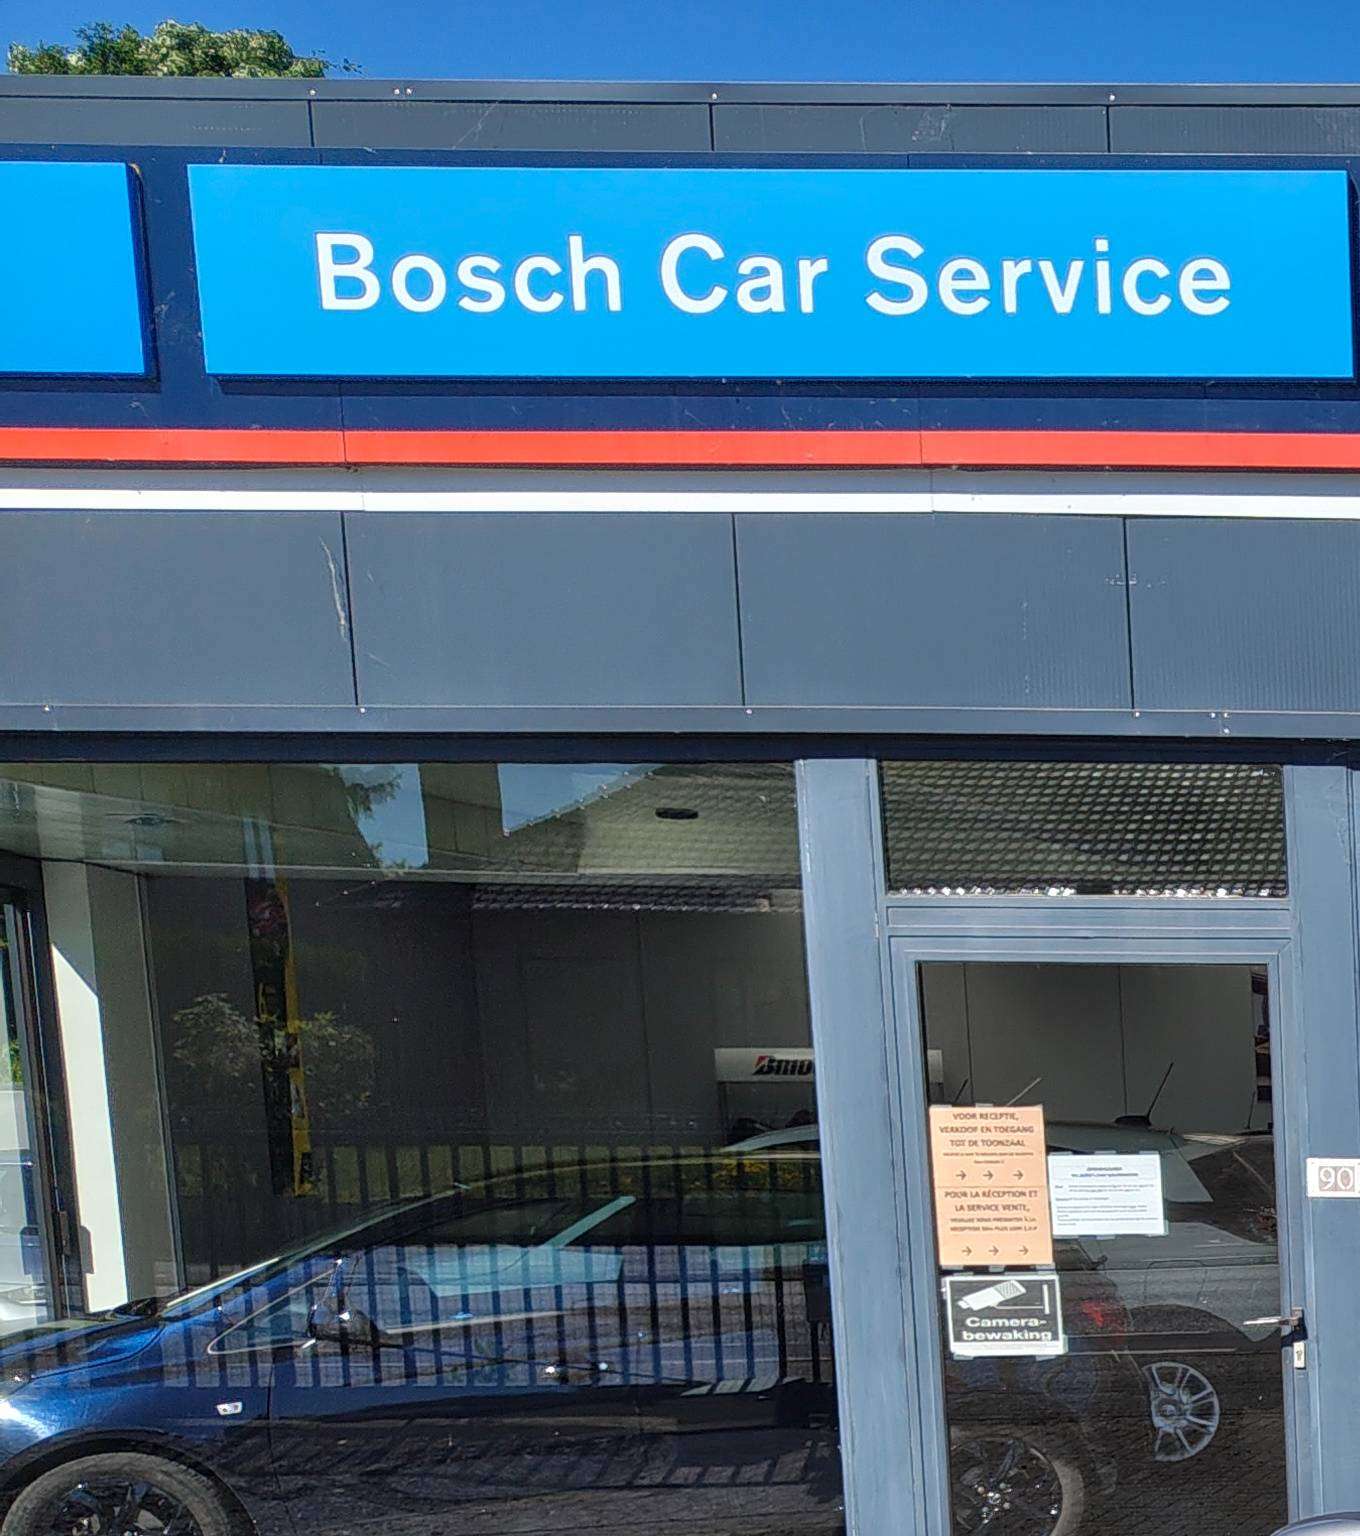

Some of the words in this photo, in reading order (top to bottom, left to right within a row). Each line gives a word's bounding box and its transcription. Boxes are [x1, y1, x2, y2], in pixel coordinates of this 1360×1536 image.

[316, 232, 621, 313] Bosch
[660, 233, 828, 314] Car
[866, 235, 1230, 316] Service
[1319, 1167, 1354, 1191] 90
[965, 1316, 1048, 1328] Camera-
[961, 1329, 1054, 1342] bewaking
